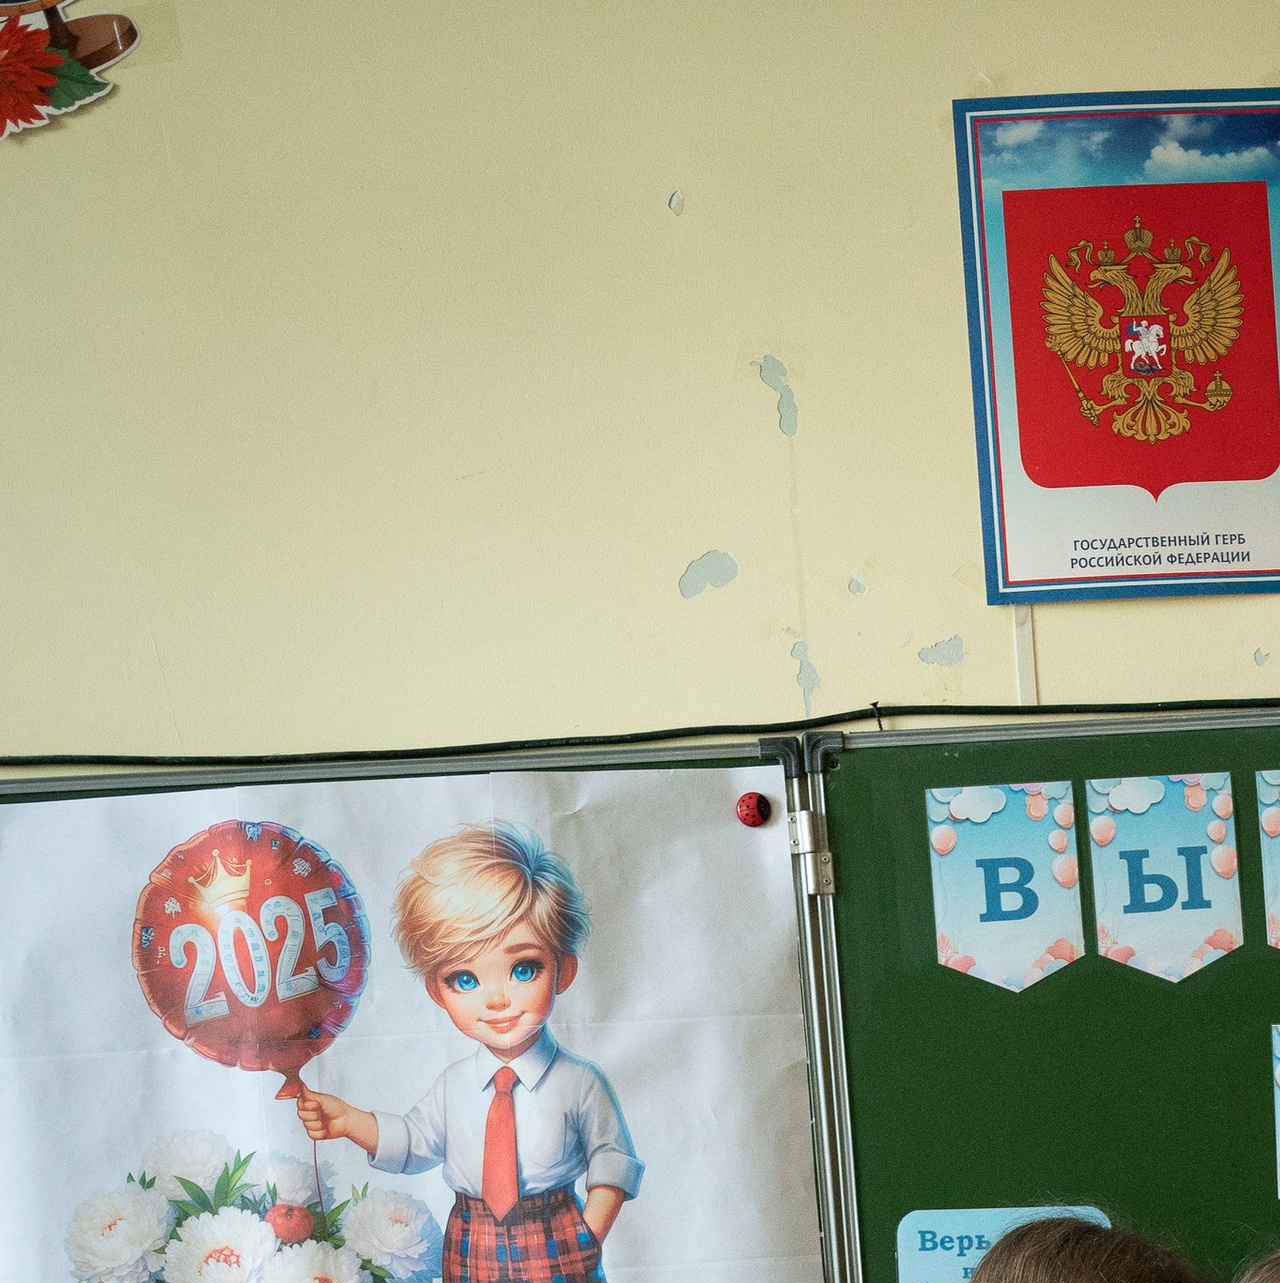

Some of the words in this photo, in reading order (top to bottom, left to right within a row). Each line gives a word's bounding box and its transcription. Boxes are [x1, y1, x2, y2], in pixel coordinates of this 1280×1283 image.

[1073, 532, 1210, 551] ГОСУДАРСТВЕННЫЙ
[1215, 533, 1246, 545] ГЕРБ
[1070, 552, 1162, 568] РОССИЙСКОЙ
[1166, 551, 1251, 565] ФЕДЕРАЦИИ
[169, 887, 351, 1027] 2025
[918, 1230, 992, 1257] Верь
